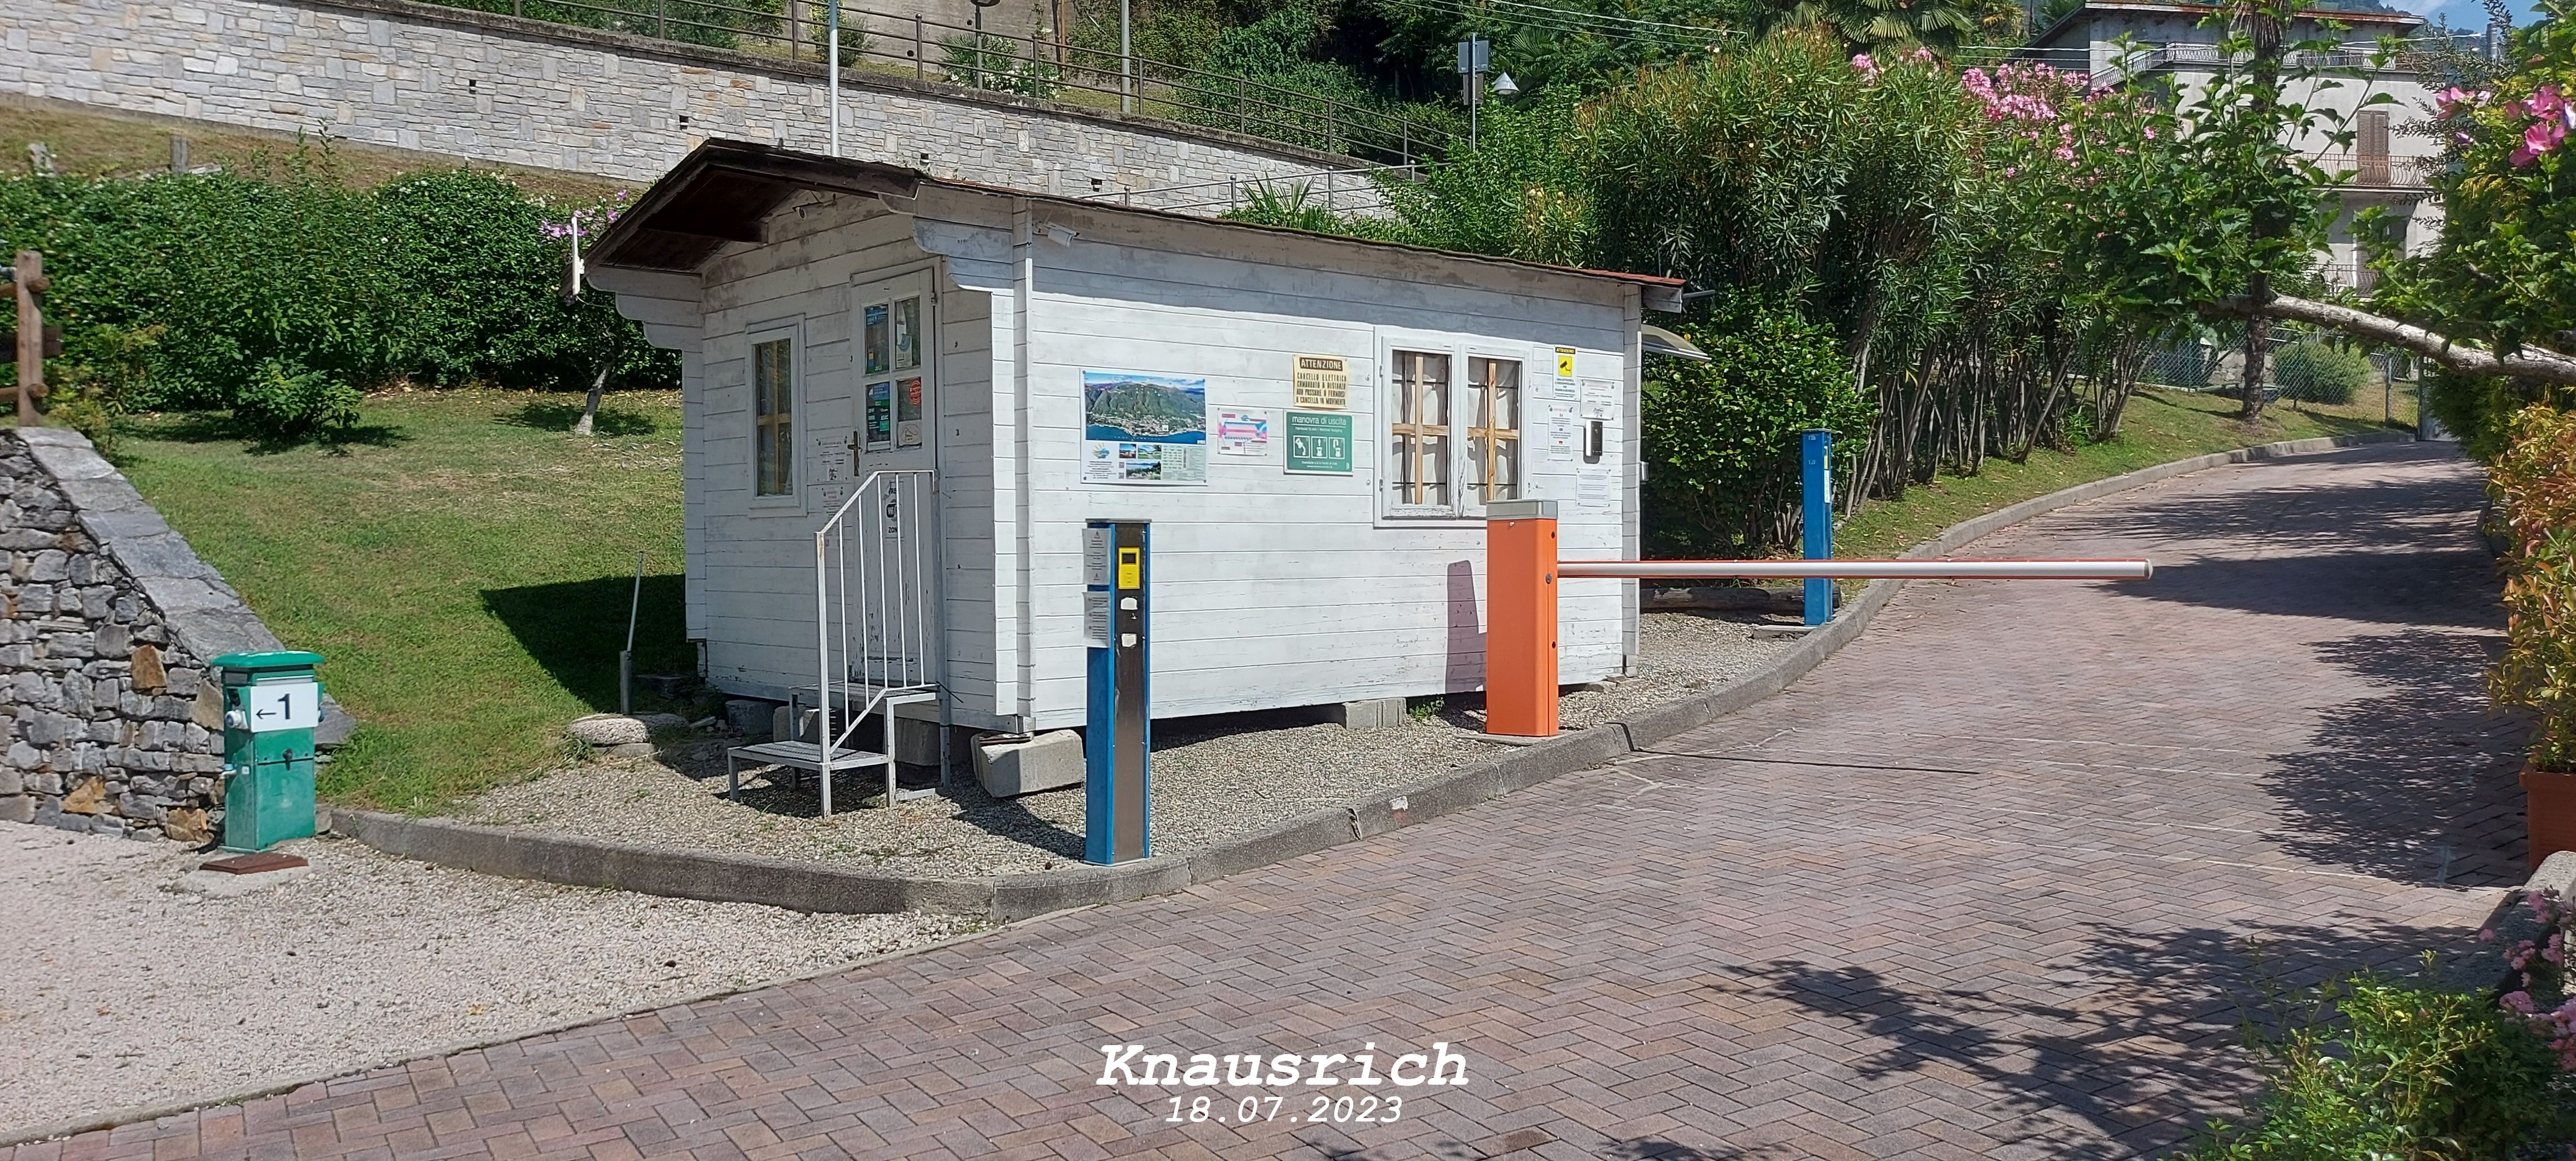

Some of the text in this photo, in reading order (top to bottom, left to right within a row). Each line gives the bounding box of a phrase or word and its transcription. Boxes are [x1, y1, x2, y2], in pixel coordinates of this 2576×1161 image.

[1301, 359, 1341, 370] ATTENZIONE
[1297, 372, 1346, 382] CANCELLO ELETTRICO
[1328, 417, 1346, 426] uscita
[277, 693, 290, 720] 1
